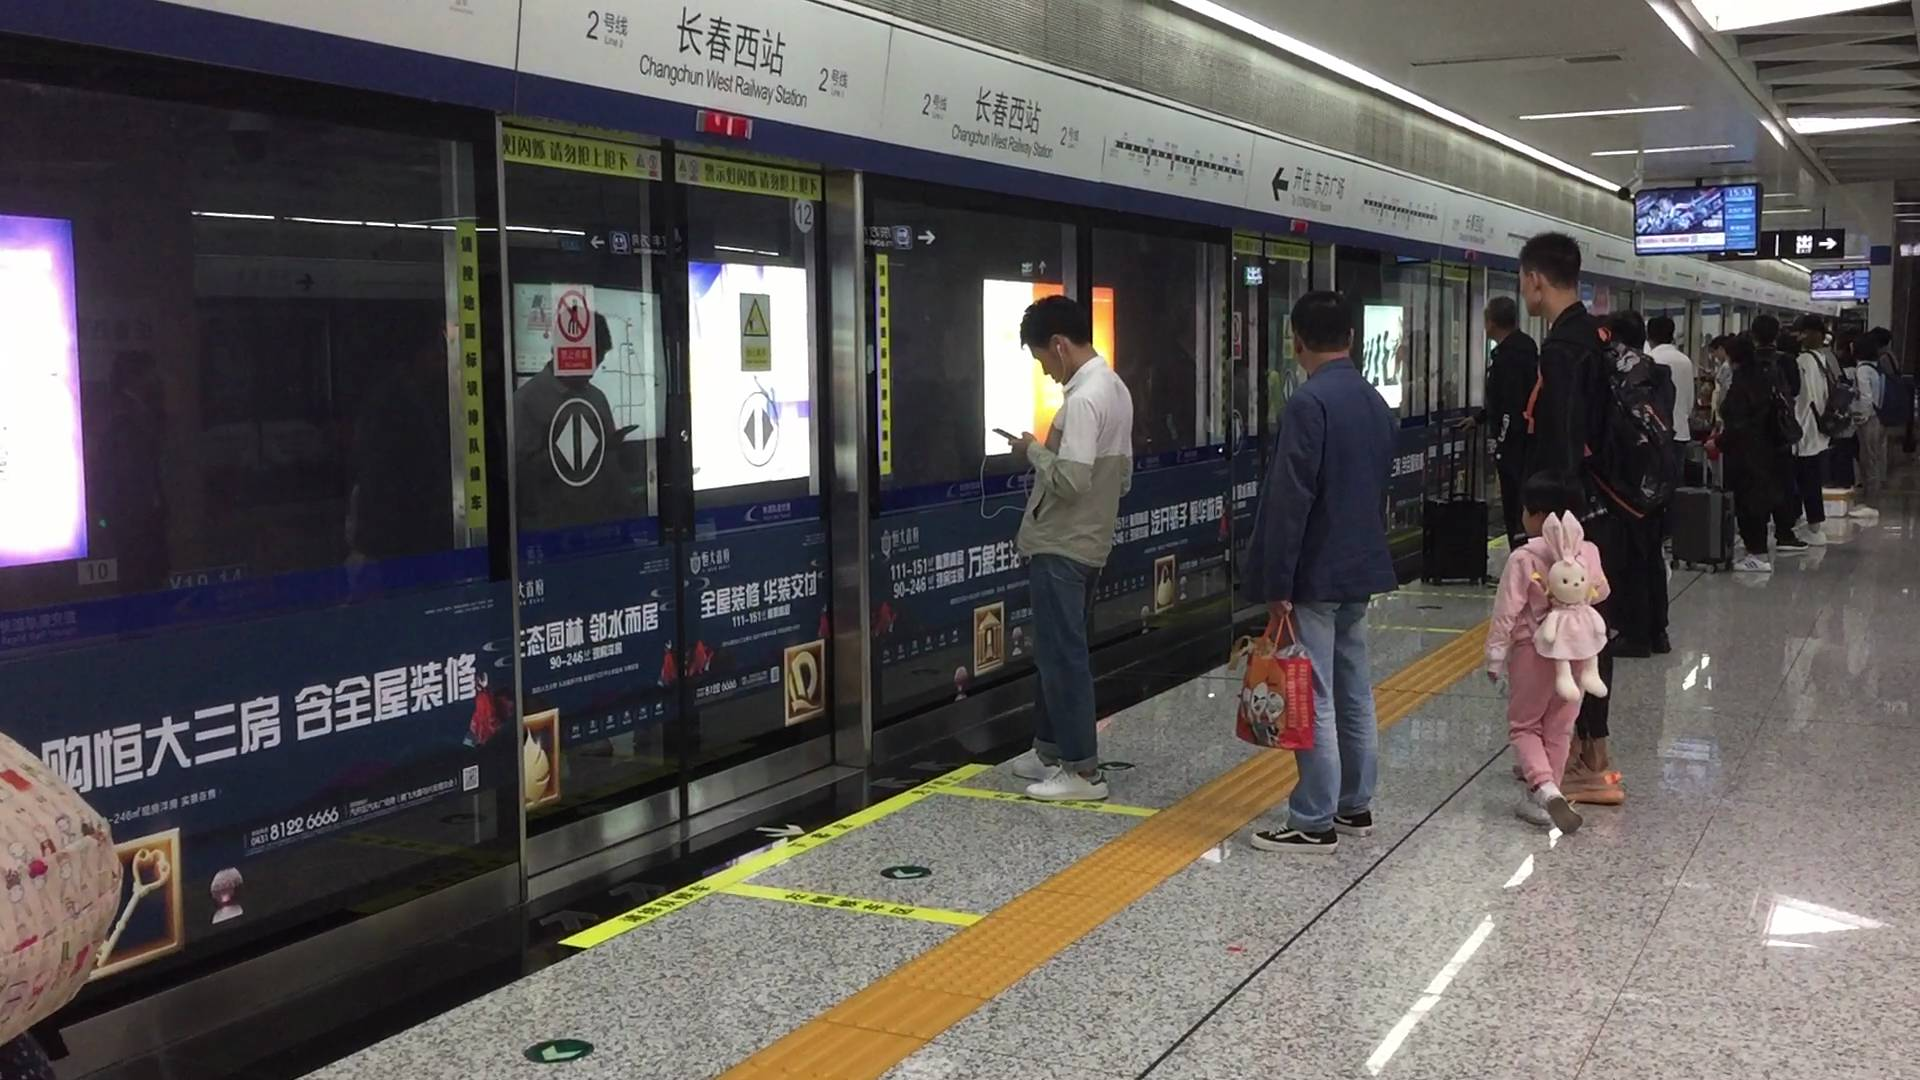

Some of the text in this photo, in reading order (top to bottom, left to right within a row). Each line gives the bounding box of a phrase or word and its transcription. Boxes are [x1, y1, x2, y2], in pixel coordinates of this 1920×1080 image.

[676, 5, 786, 77] 长春西站
[639, 53, 808, 108] Changchun West Railway Station
[975, 85, 1042, 135] 长春西站
[951, 123, 990, 147] Changchun
[550, 141, 628, 171] 请勿抢上抢下
[1314, 172, 1346, 200] 东方广场
[798, 203, 812, 225] 12
[88, 562, 108, 581] 10
[890, 557, 928, 581] 111-151
[700, 582, 760, 619] 全屋装修
[763, 570, 817, 604] 华装交付
[893, 576, 927, 600] 90-246
[589, 602, 658, 643] 邻水而居
[550, 649, 584, 670] 90-246
[41, 653, 476, 792] 购恒大三房 含全屋装修
[270, 816, 304, 841] 8122
[306, 806, 340, 830] 6666
